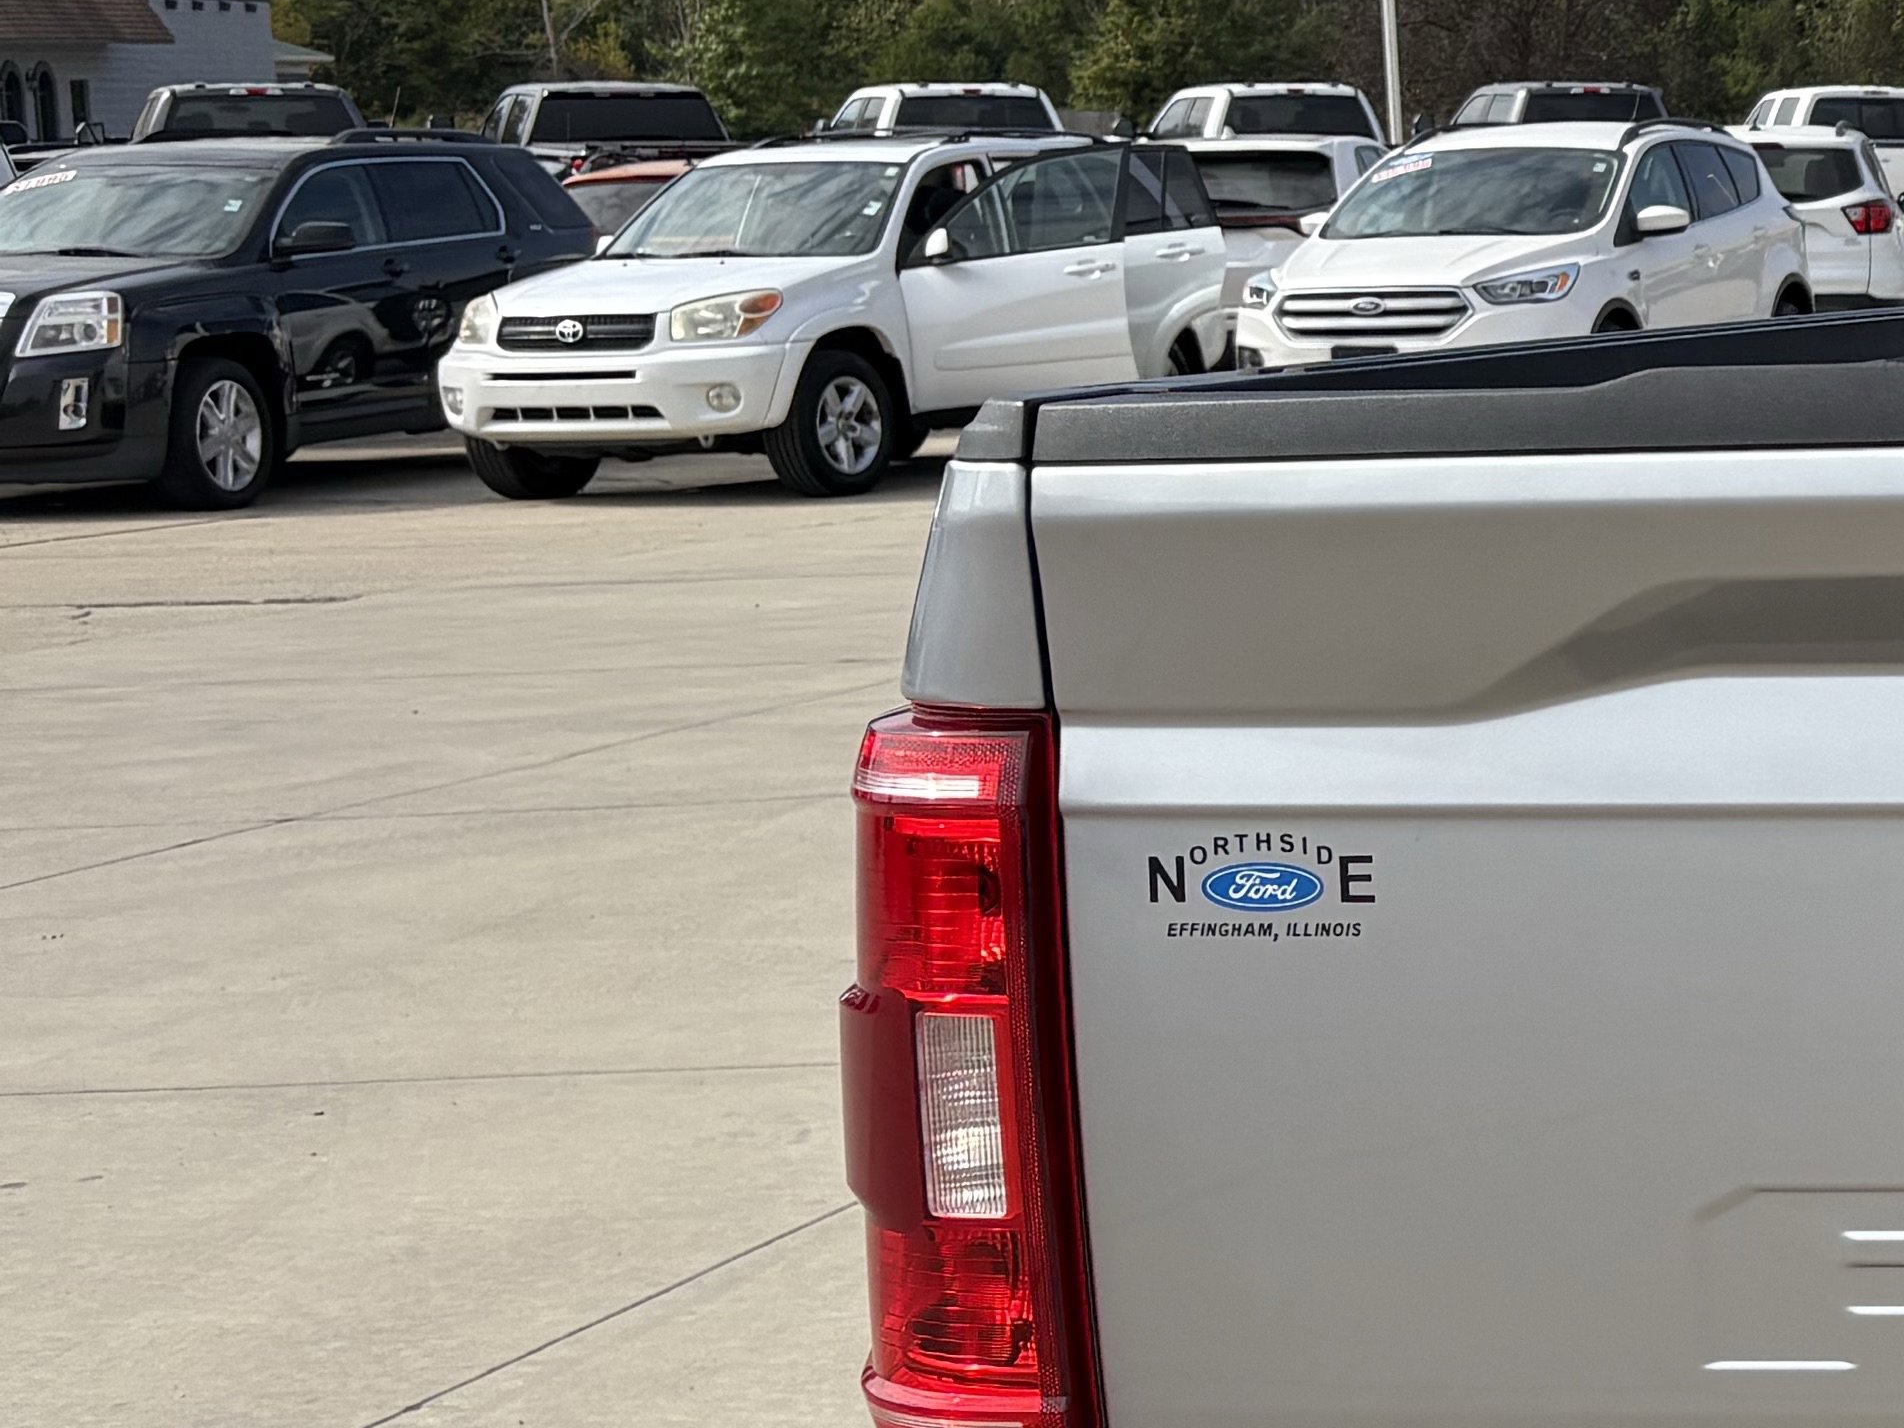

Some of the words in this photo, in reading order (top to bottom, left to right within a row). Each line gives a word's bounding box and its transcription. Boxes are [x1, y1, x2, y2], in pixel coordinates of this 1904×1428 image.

[1148, 832, 1376, 903] NORTHSIDE
[1228, 870, 1298, 900] Ford
[1167, 922, 1280, 942] EFFINGHAM,
[1286, 922, 1362, 937] ILLINOIS
